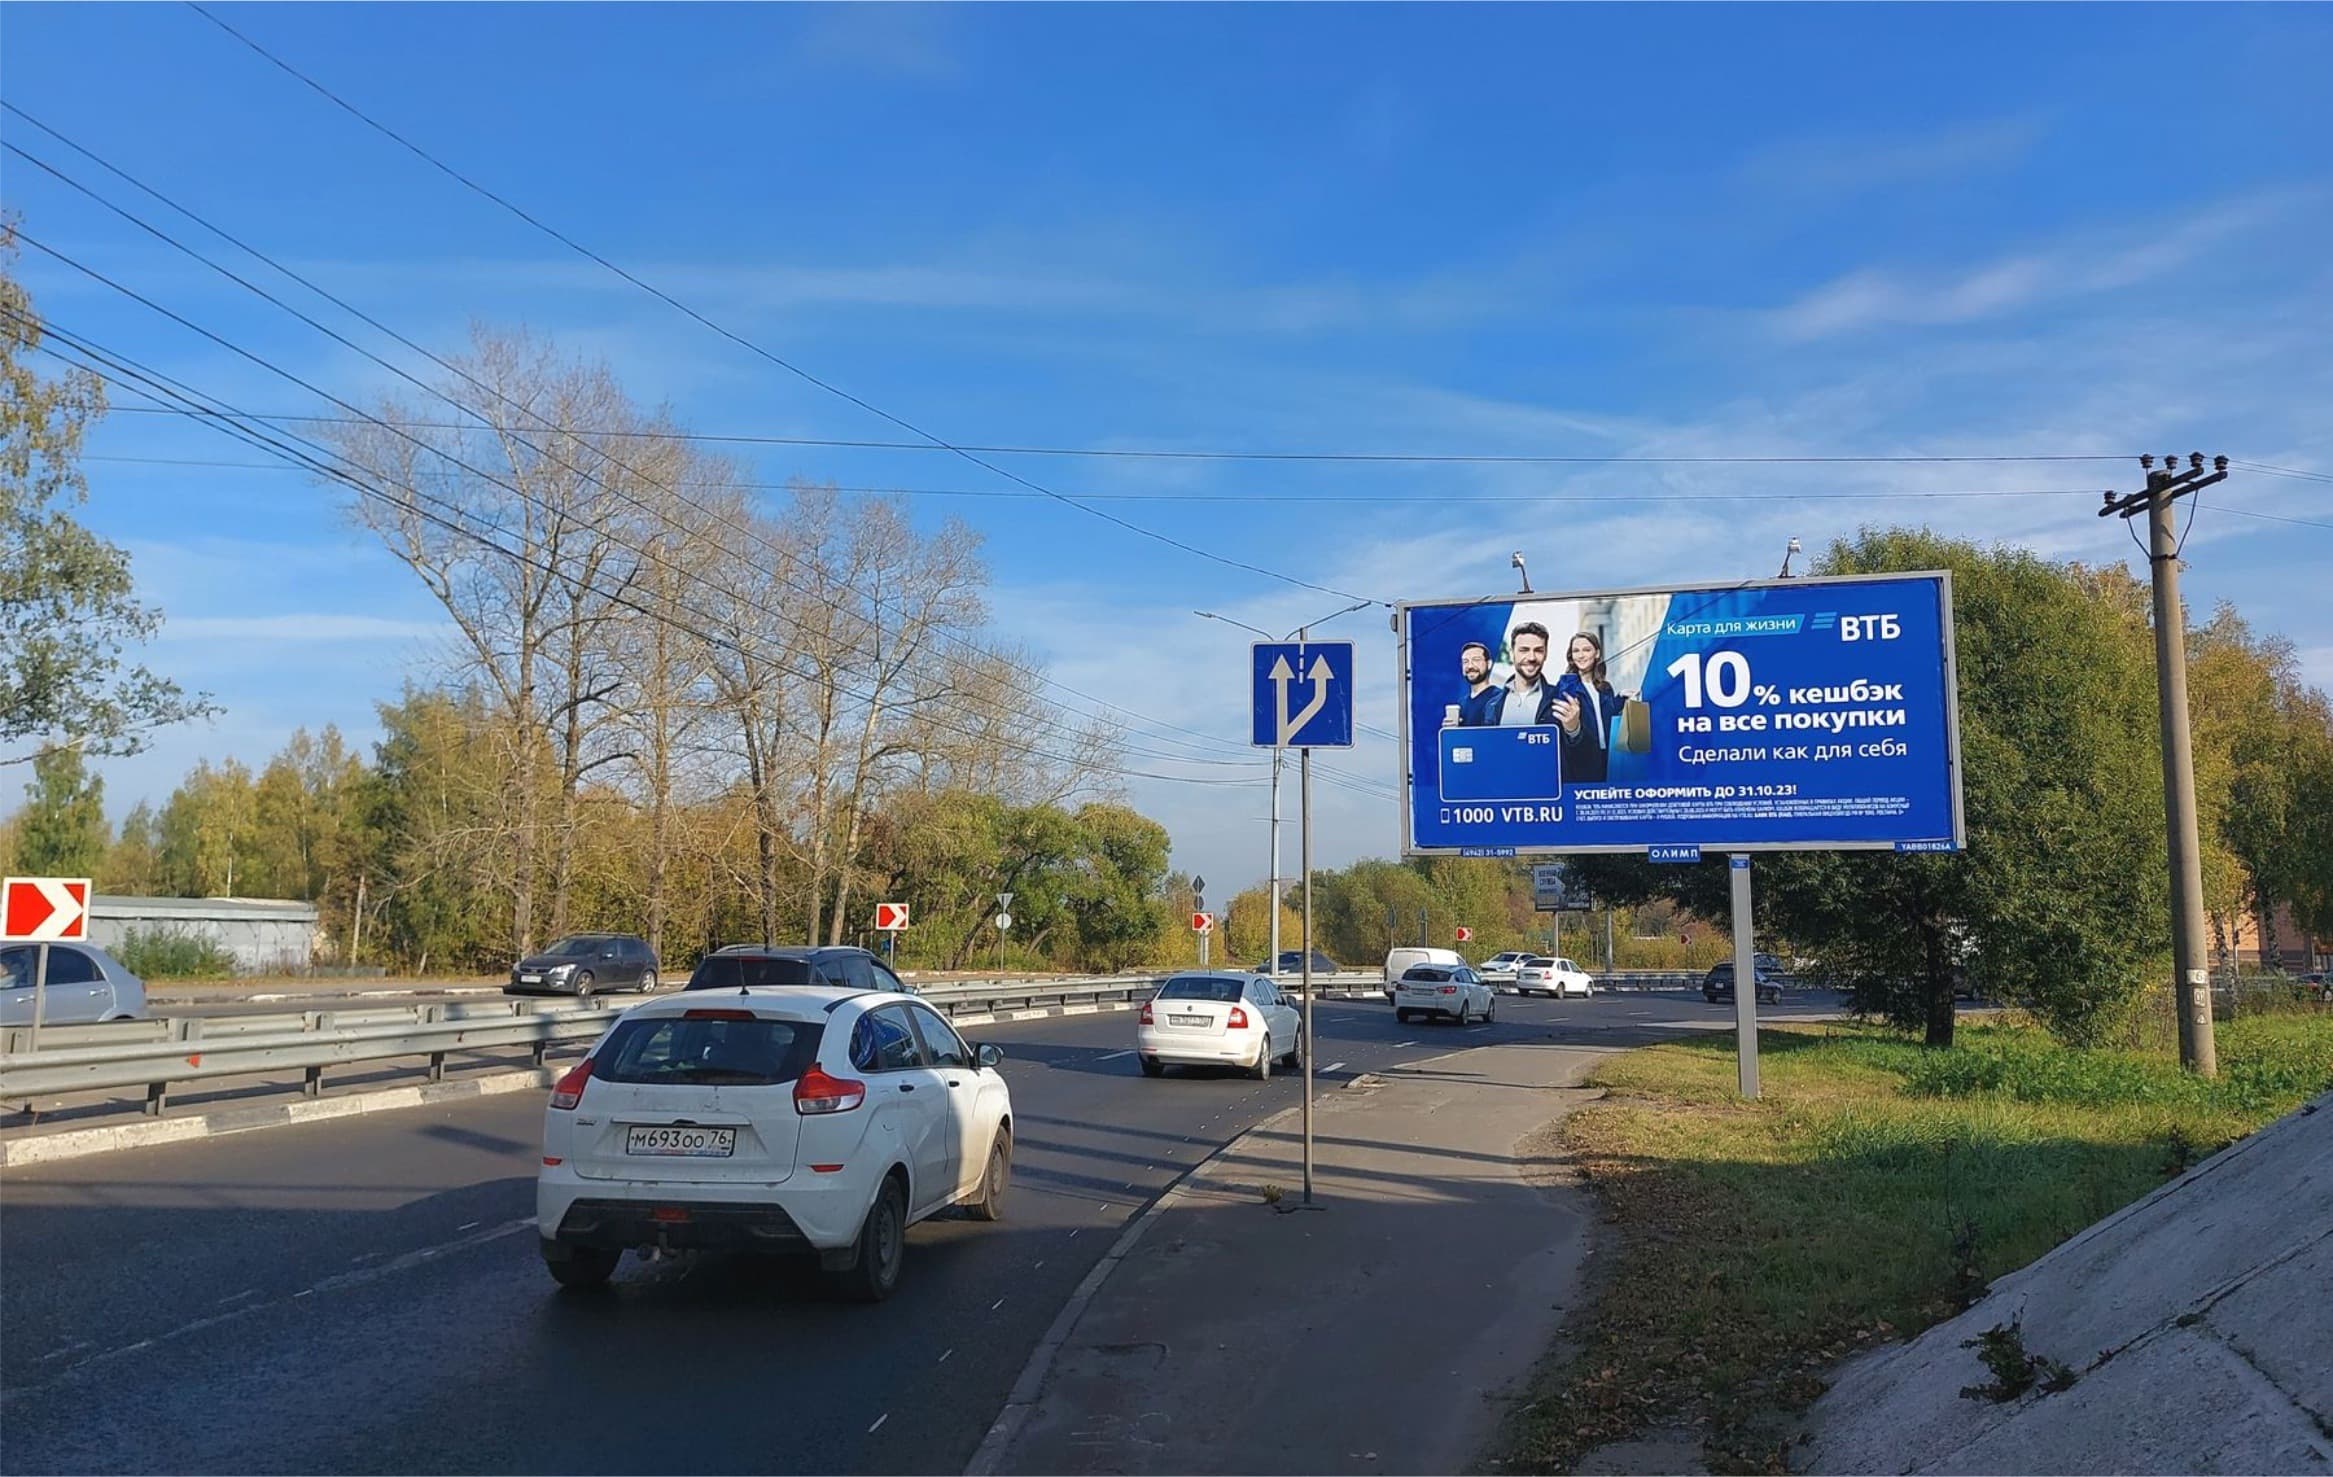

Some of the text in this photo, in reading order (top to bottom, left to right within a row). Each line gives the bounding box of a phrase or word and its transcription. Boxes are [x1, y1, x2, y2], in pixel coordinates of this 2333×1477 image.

[1666, 618, 1796, 637] Карта для жизни
[1840, 614, 1901, 642] ВТБ
[1789, 678, 1903, 705] кешбэк
[1677, 709, 1906, 733] на все покупки
[1527, 733, 1551, 745] ВТБ
[1678, 738, 1908, 765] Сделали как для себя
[1574, 785, 1797, 800] УСПЕЙТЕ ОФОРМИТЬ ДО 31.10.23!
[1453, 808, 1494, 824] 1000
[1501, 807, 1563, 823] VTB.RU
[1651, 849, 1698, 859] ОЛИМП
[711, 1131, 727, 1144] 76
